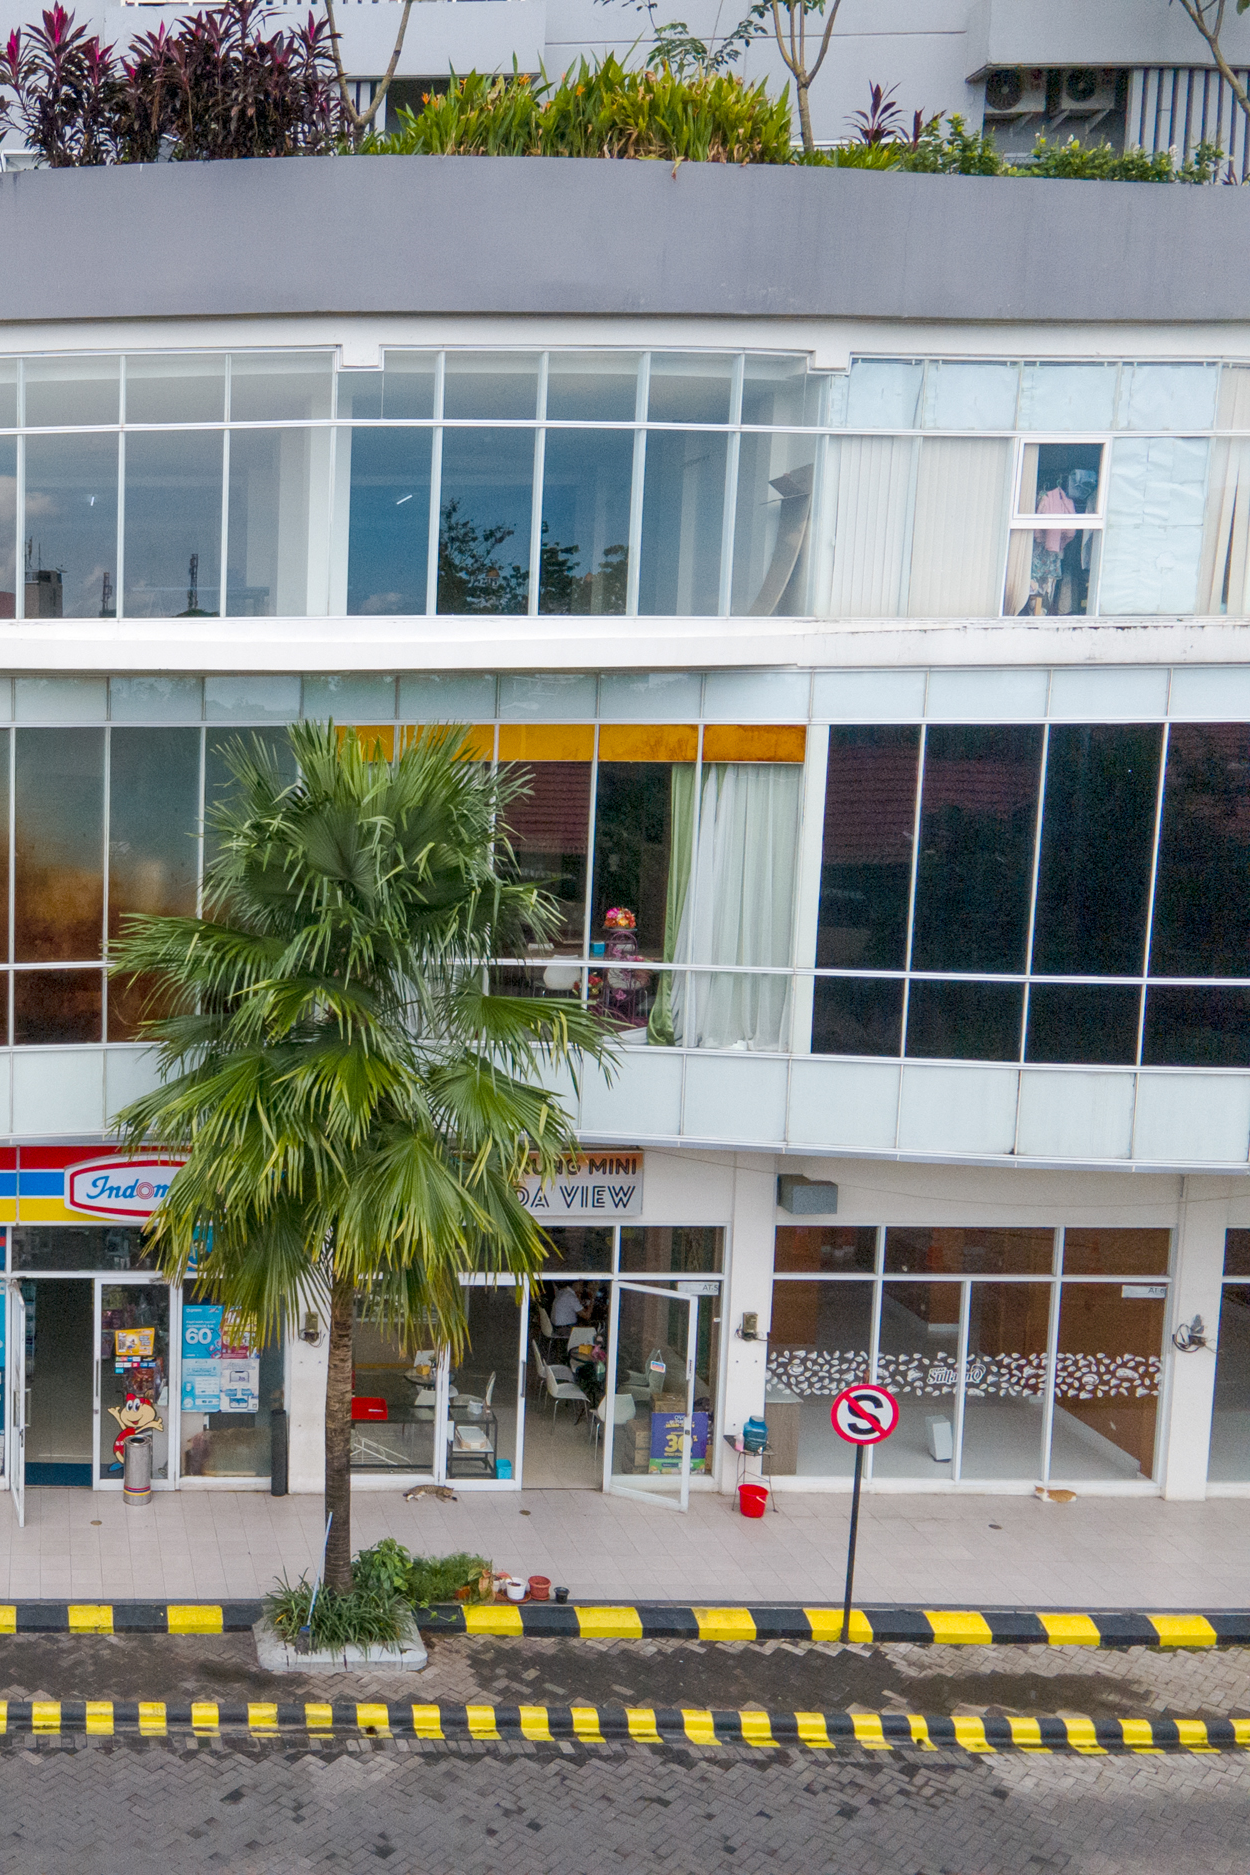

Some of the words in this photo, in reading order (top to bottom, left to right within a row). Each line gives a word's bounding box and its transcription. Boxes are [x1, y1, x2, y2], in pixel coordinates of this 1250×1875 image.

[588, 1159, 637, 1175] MINI
[86, 1175, 170, 1200] Indom
[559, 1185, 636, 1209] VIEW
[185, 1327, 212, 1345] 60
[847, 1394, 884, 1435] S
